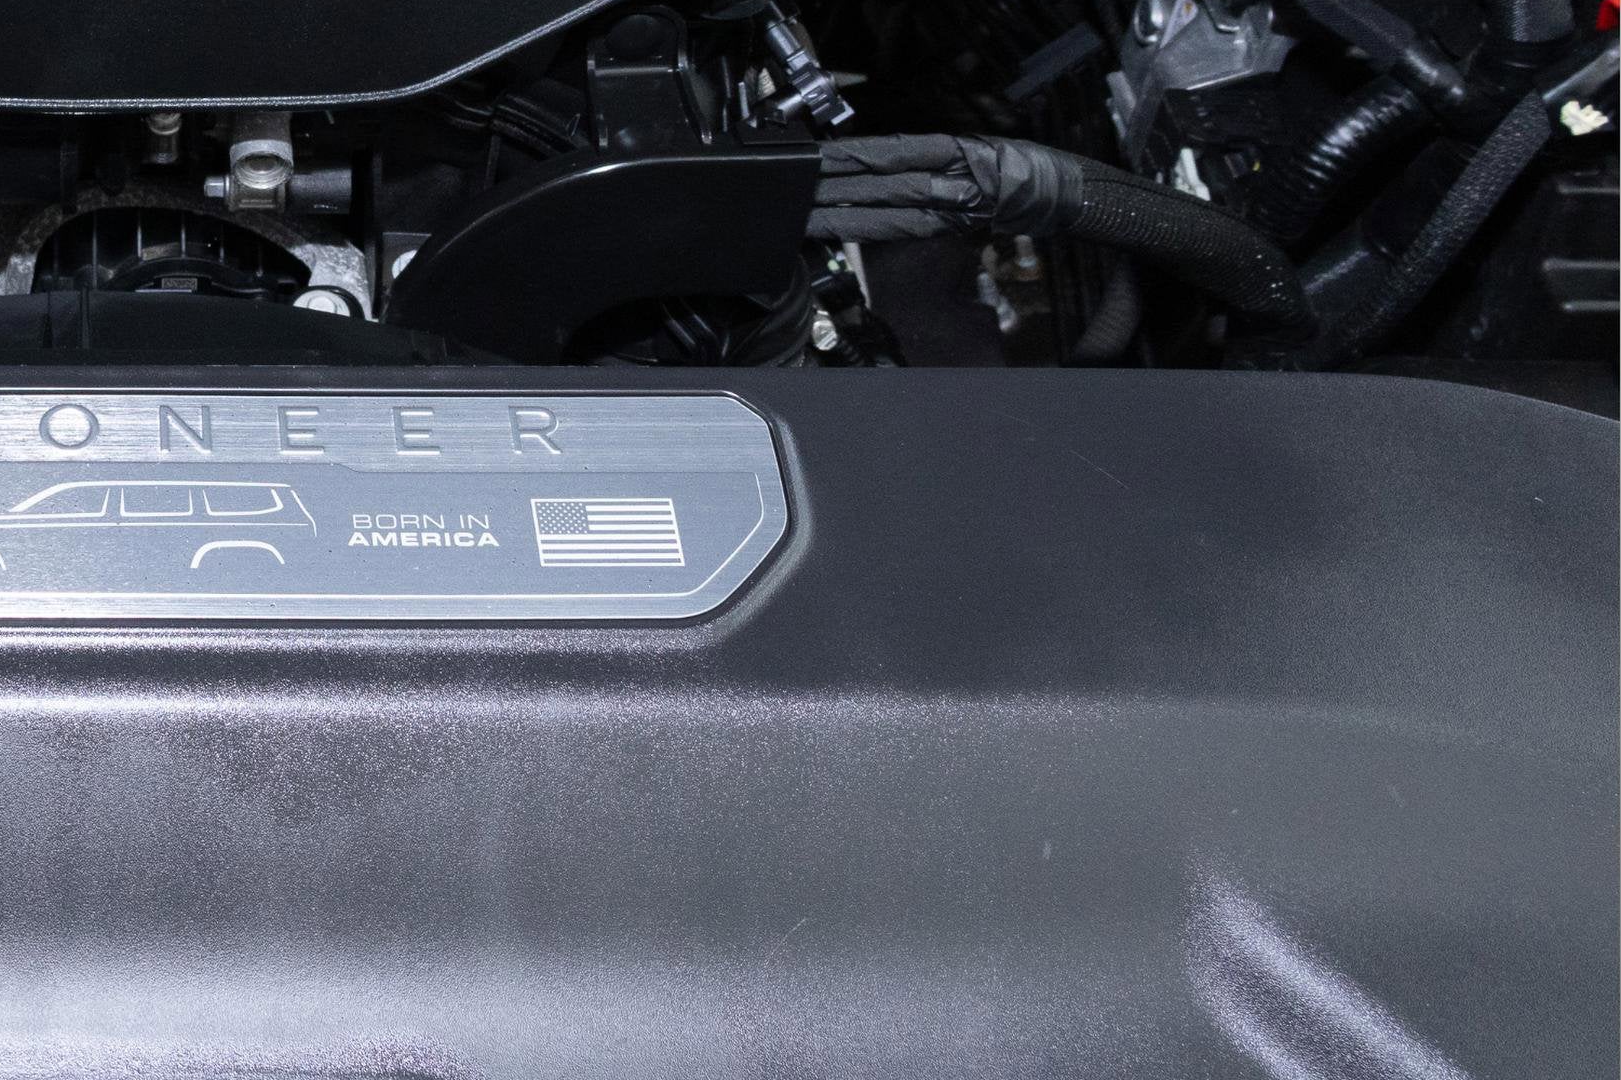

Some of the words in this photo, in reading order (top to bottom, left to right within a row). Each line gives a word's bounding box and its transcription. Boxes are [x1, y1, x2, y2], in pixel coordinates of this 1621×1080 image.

[352, 514, 445, 529] BORN
[459, 514, 490, 530] IN
[347, 531, 500, 547] AMERICA
